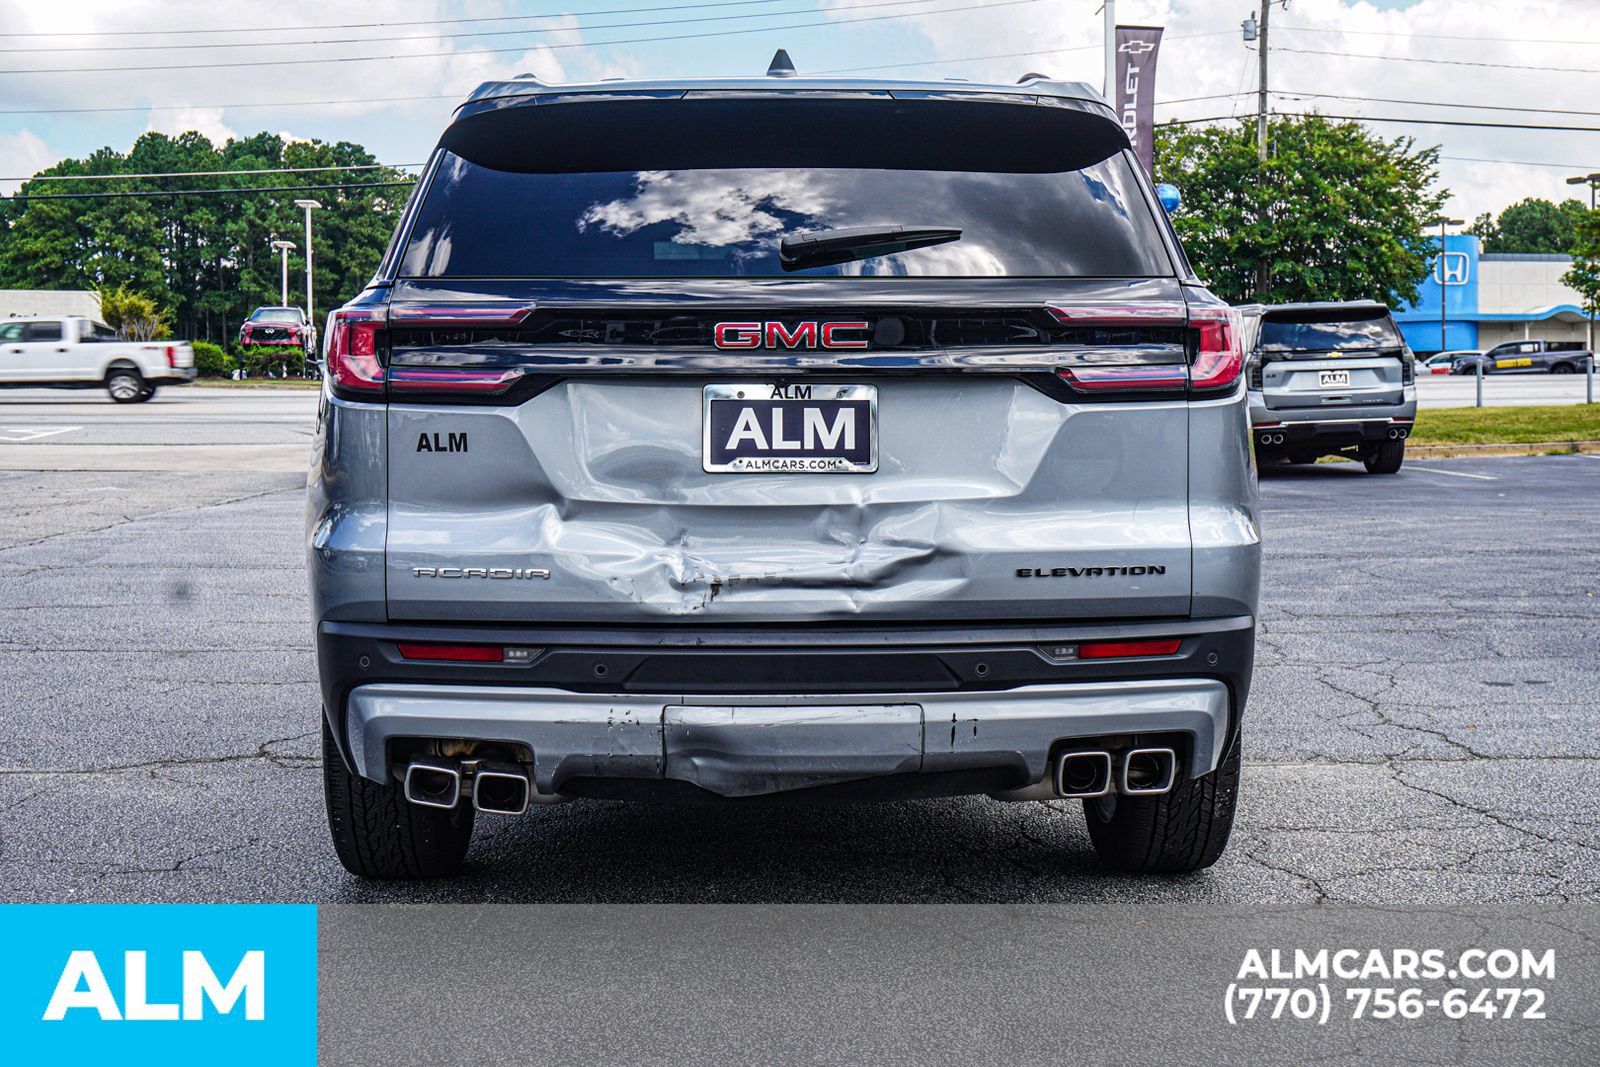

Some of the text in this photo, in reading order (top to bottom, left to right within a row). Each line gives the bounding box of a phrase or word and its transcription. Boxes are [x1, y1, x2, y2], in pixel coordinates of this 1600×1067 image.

[714, 321, 869, 349] GMC
[1323, 374, 1346, 384] ALM
[770, 385, 812, 400] ALM
[725, 407, 856, 450] ALM
[416, 432, 468, 453] ALM
[745, 459, 837, 470] ALMCARS.COM
[412, 566, 551, 580] ACADIA
[1015, 565, 1167, 578] ELEVATION
